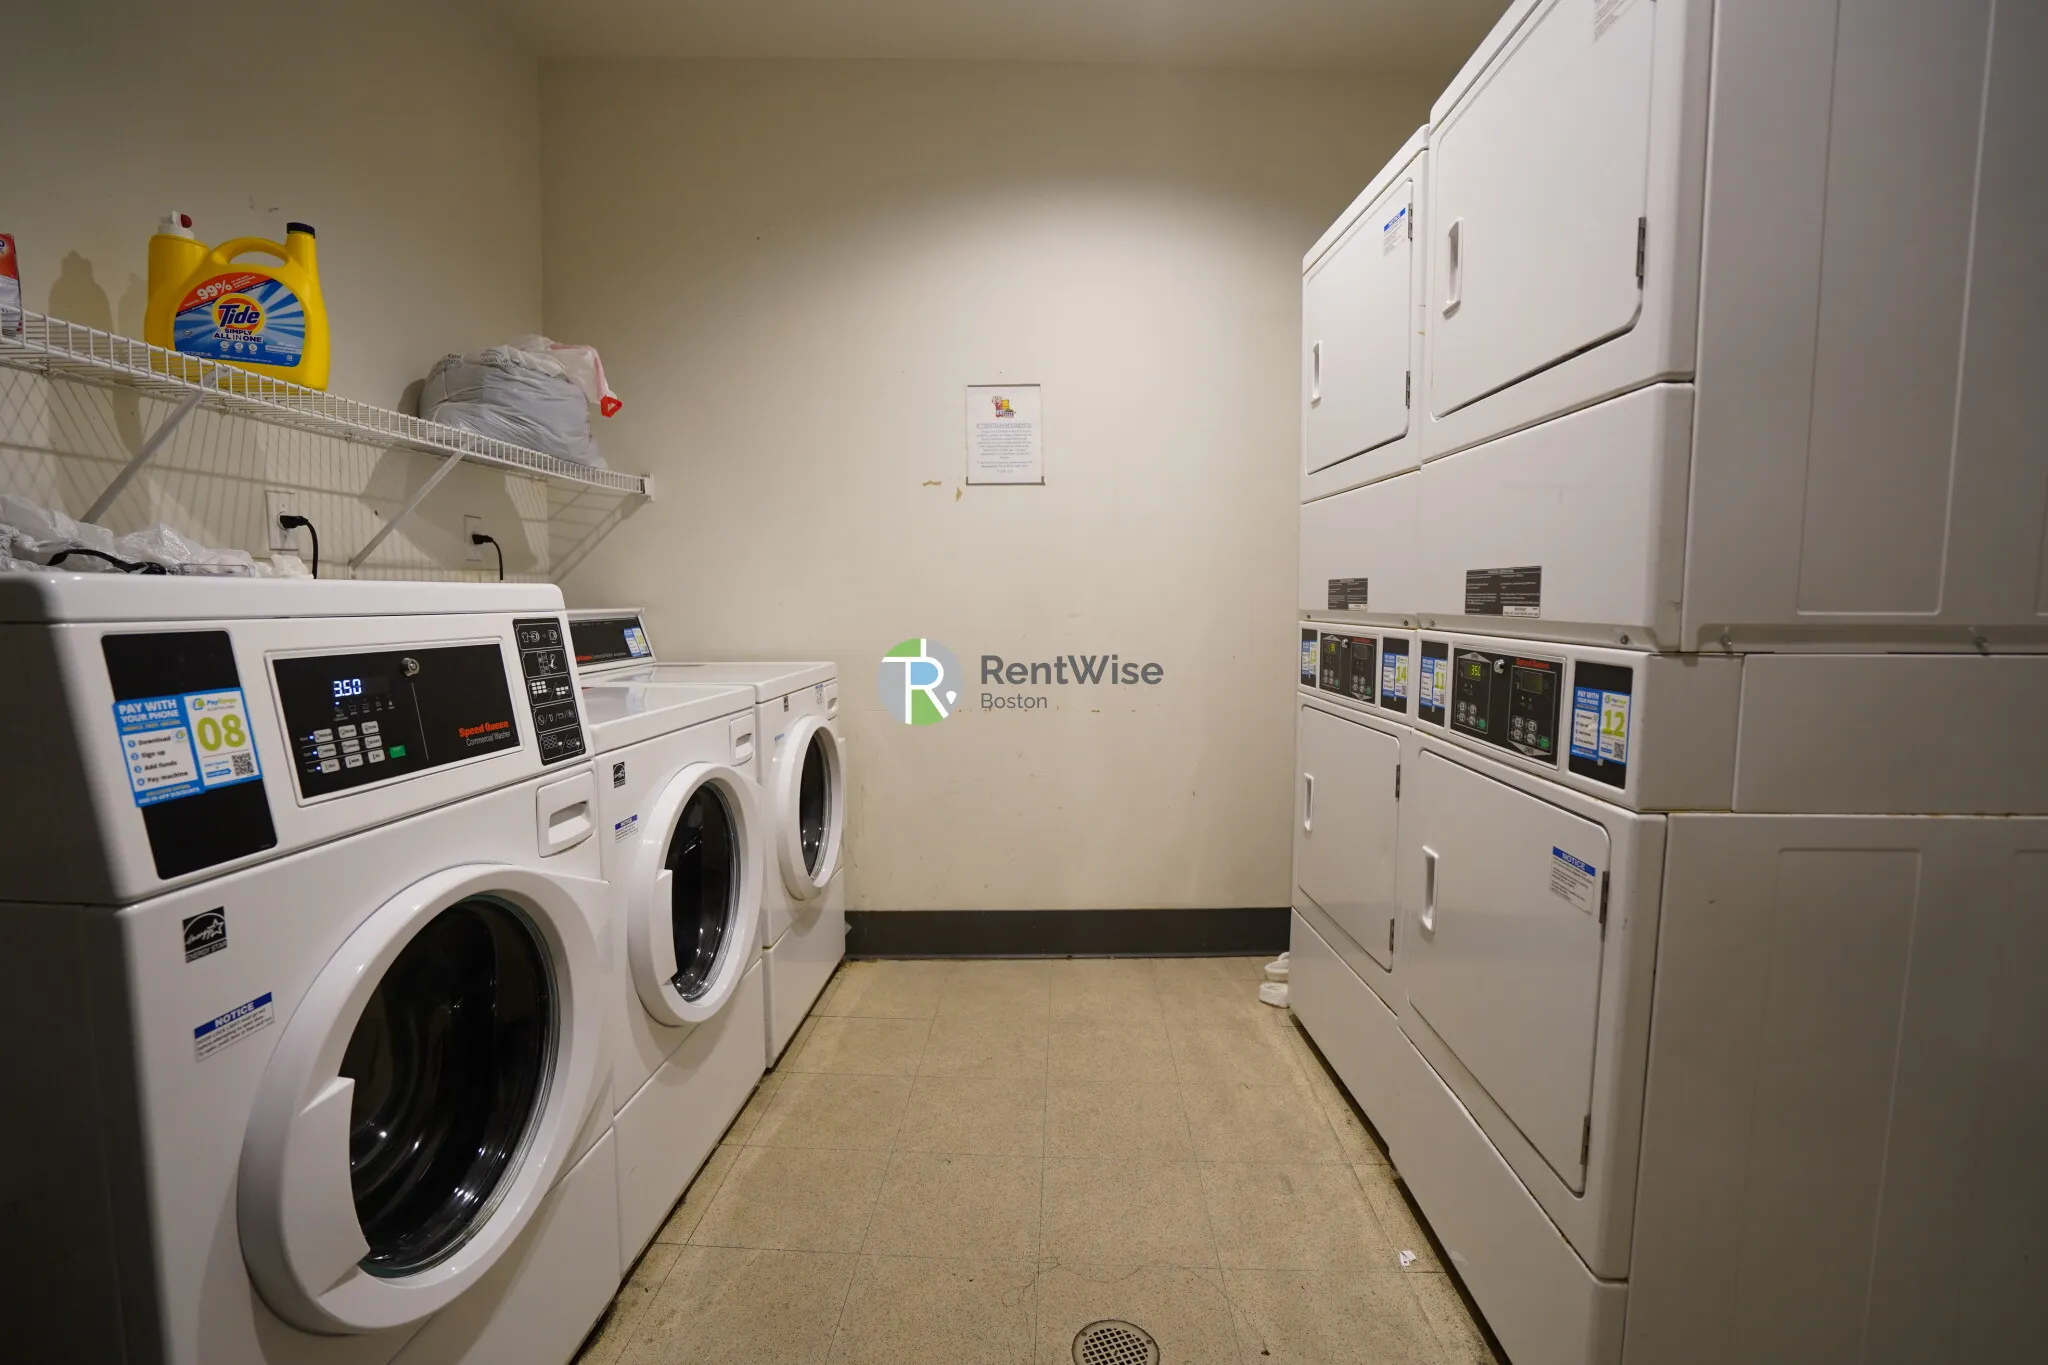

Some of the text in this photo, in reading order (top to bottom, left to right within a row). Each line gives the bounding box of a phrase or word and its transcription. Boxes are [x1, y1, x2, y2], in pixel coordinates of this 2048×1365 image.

[197, 280, 232, 300] 99%
[219, 304, 260, 327] Tide
[225, 328, 252, 336] SIMPLY
[1396, 666, 1407, 682] 14
[1434, 671, 1445, 690] 11
[119, 699, 177, 715] PAY WITH
[121, 709, 179, 723] YOUR PHONE
[1602, 709, 1625, 738] 12
[197, 714, 246, 751] 08
[458, 720, 509, 738] Speed Queen
[138, 735, 171, 745] Download
[466, 731, 511, 746] Commercial Washer
[141, 752, 155, 760] Sign
[144, 760, 177, 771] Add funds
[147, 770, 188, 784] Pay machine
[1562, 852, 1586, 870] NOTICE
[186, 941, 227, 961] ENERGY STAR
[214, 1001, 255, 1028] NOTICE
